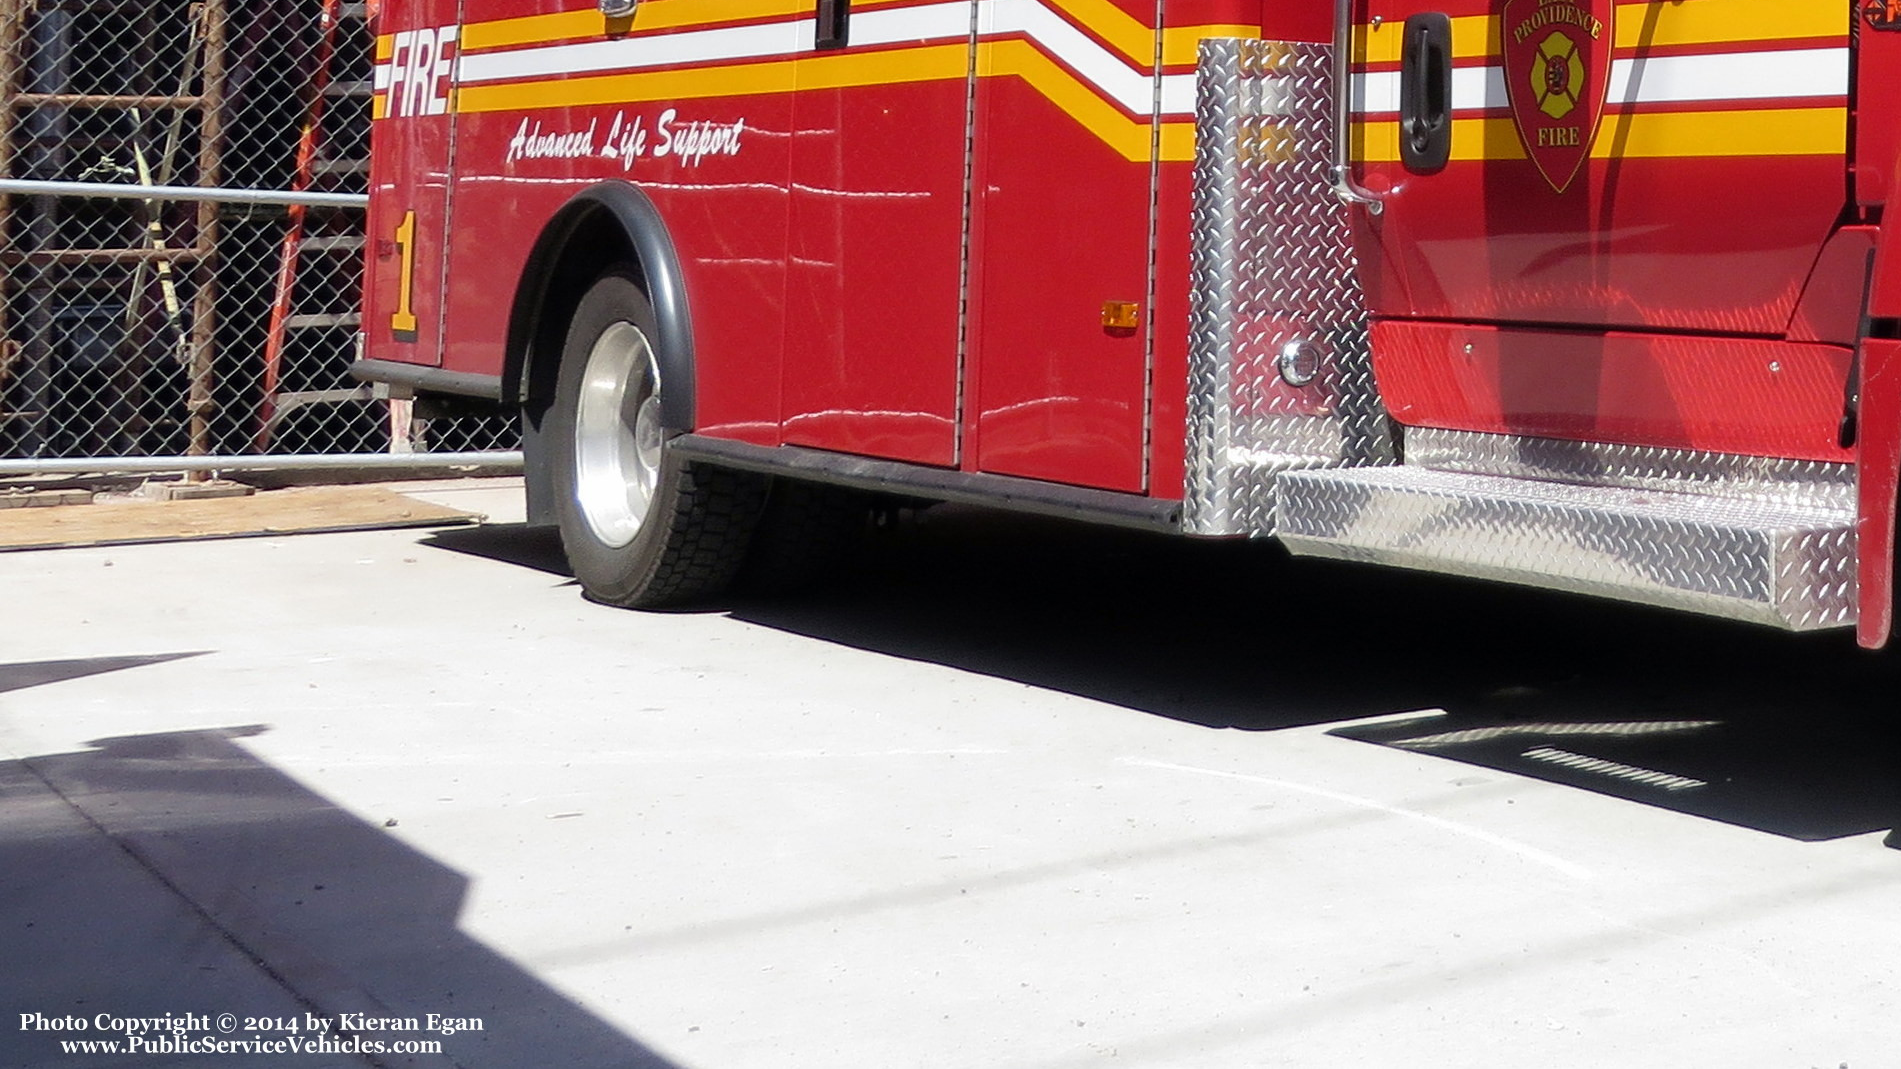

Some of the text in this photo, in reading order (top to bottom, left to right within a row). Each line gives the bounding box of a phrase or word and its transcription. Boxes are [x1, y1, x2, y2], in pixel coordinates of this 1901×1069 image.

[1513, 6, 1603, 44] PROVIDENCE
[385, 24, 459, 119] FIRE
[506, 107, 743, 172] Advanced Life Support
[1538, 126, 1580, 147] FIRE
[391, 210, 417, 332] 1
